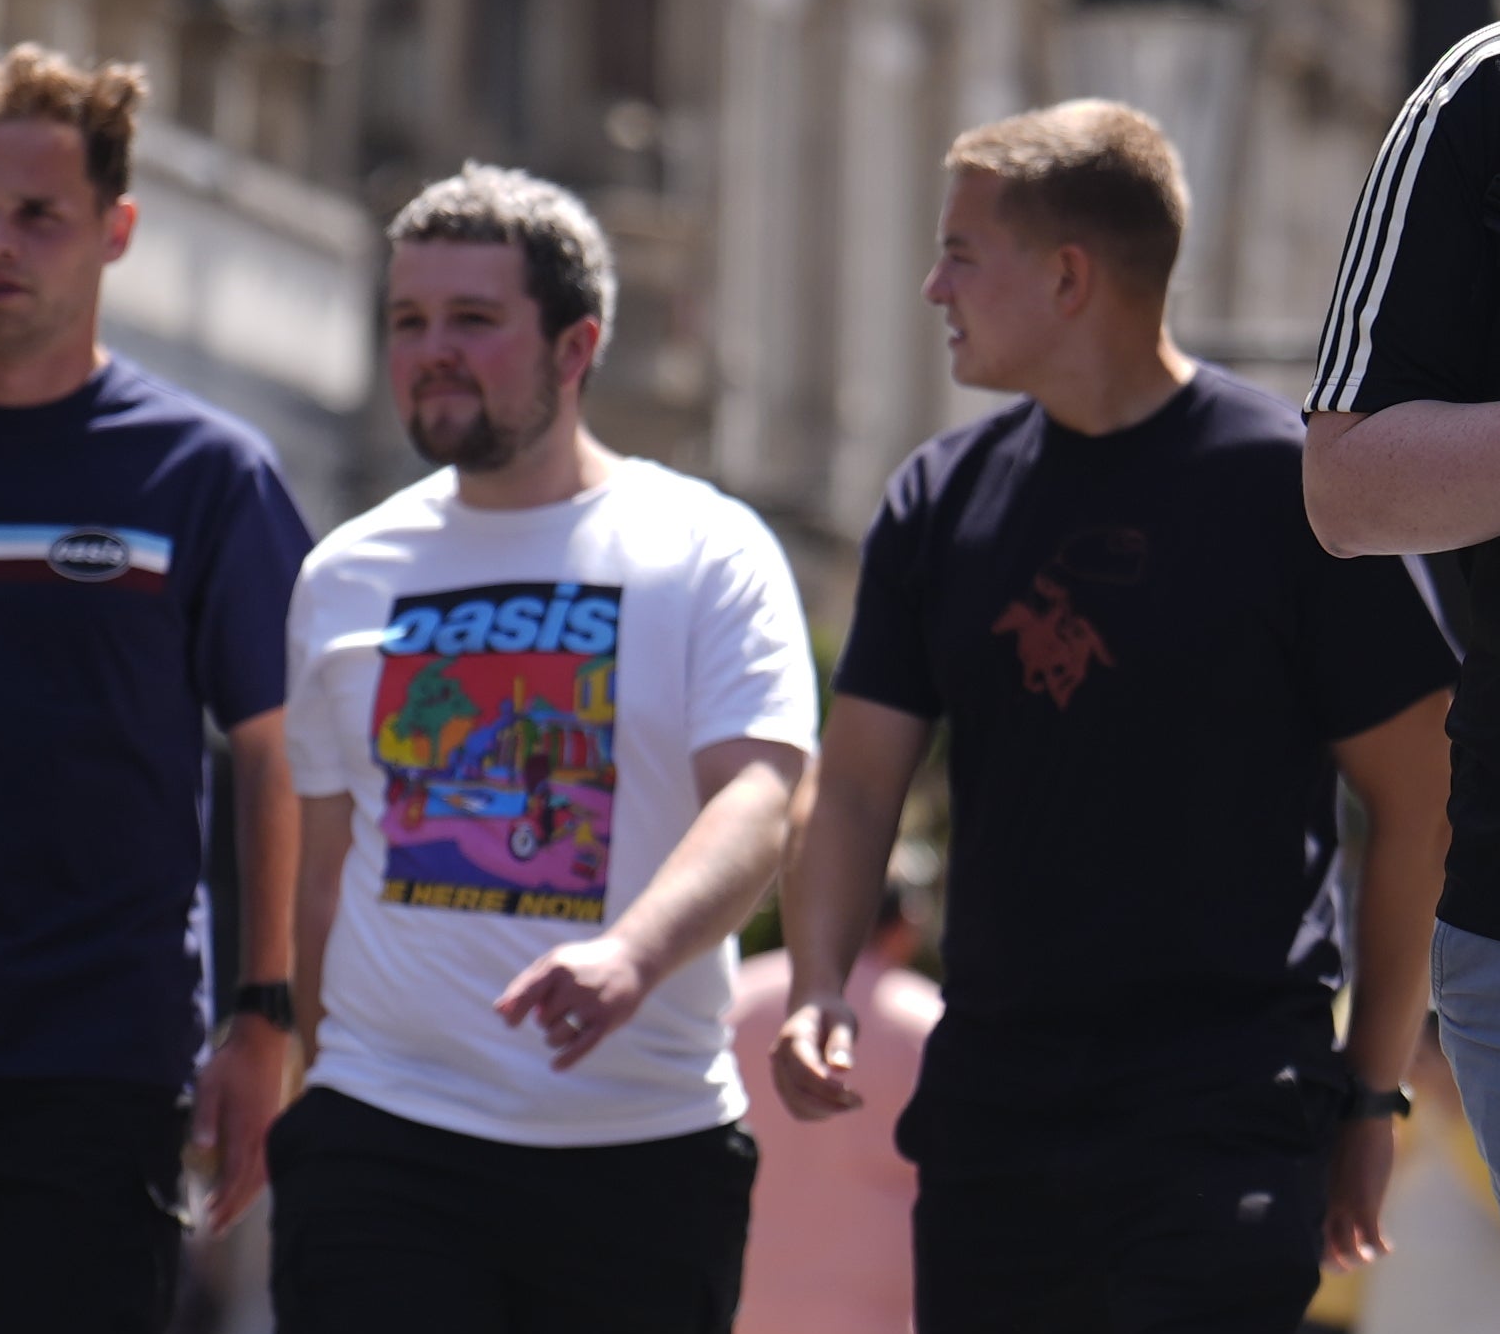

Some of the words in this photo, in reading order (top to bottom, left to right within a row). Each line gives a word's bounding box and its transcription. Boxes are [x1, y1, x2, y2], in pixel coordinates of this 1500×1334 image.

[383, 583, 619, 655] oasis
[409, 882, 509, 914] HERE
[516, 892, 604, 923] NOW
